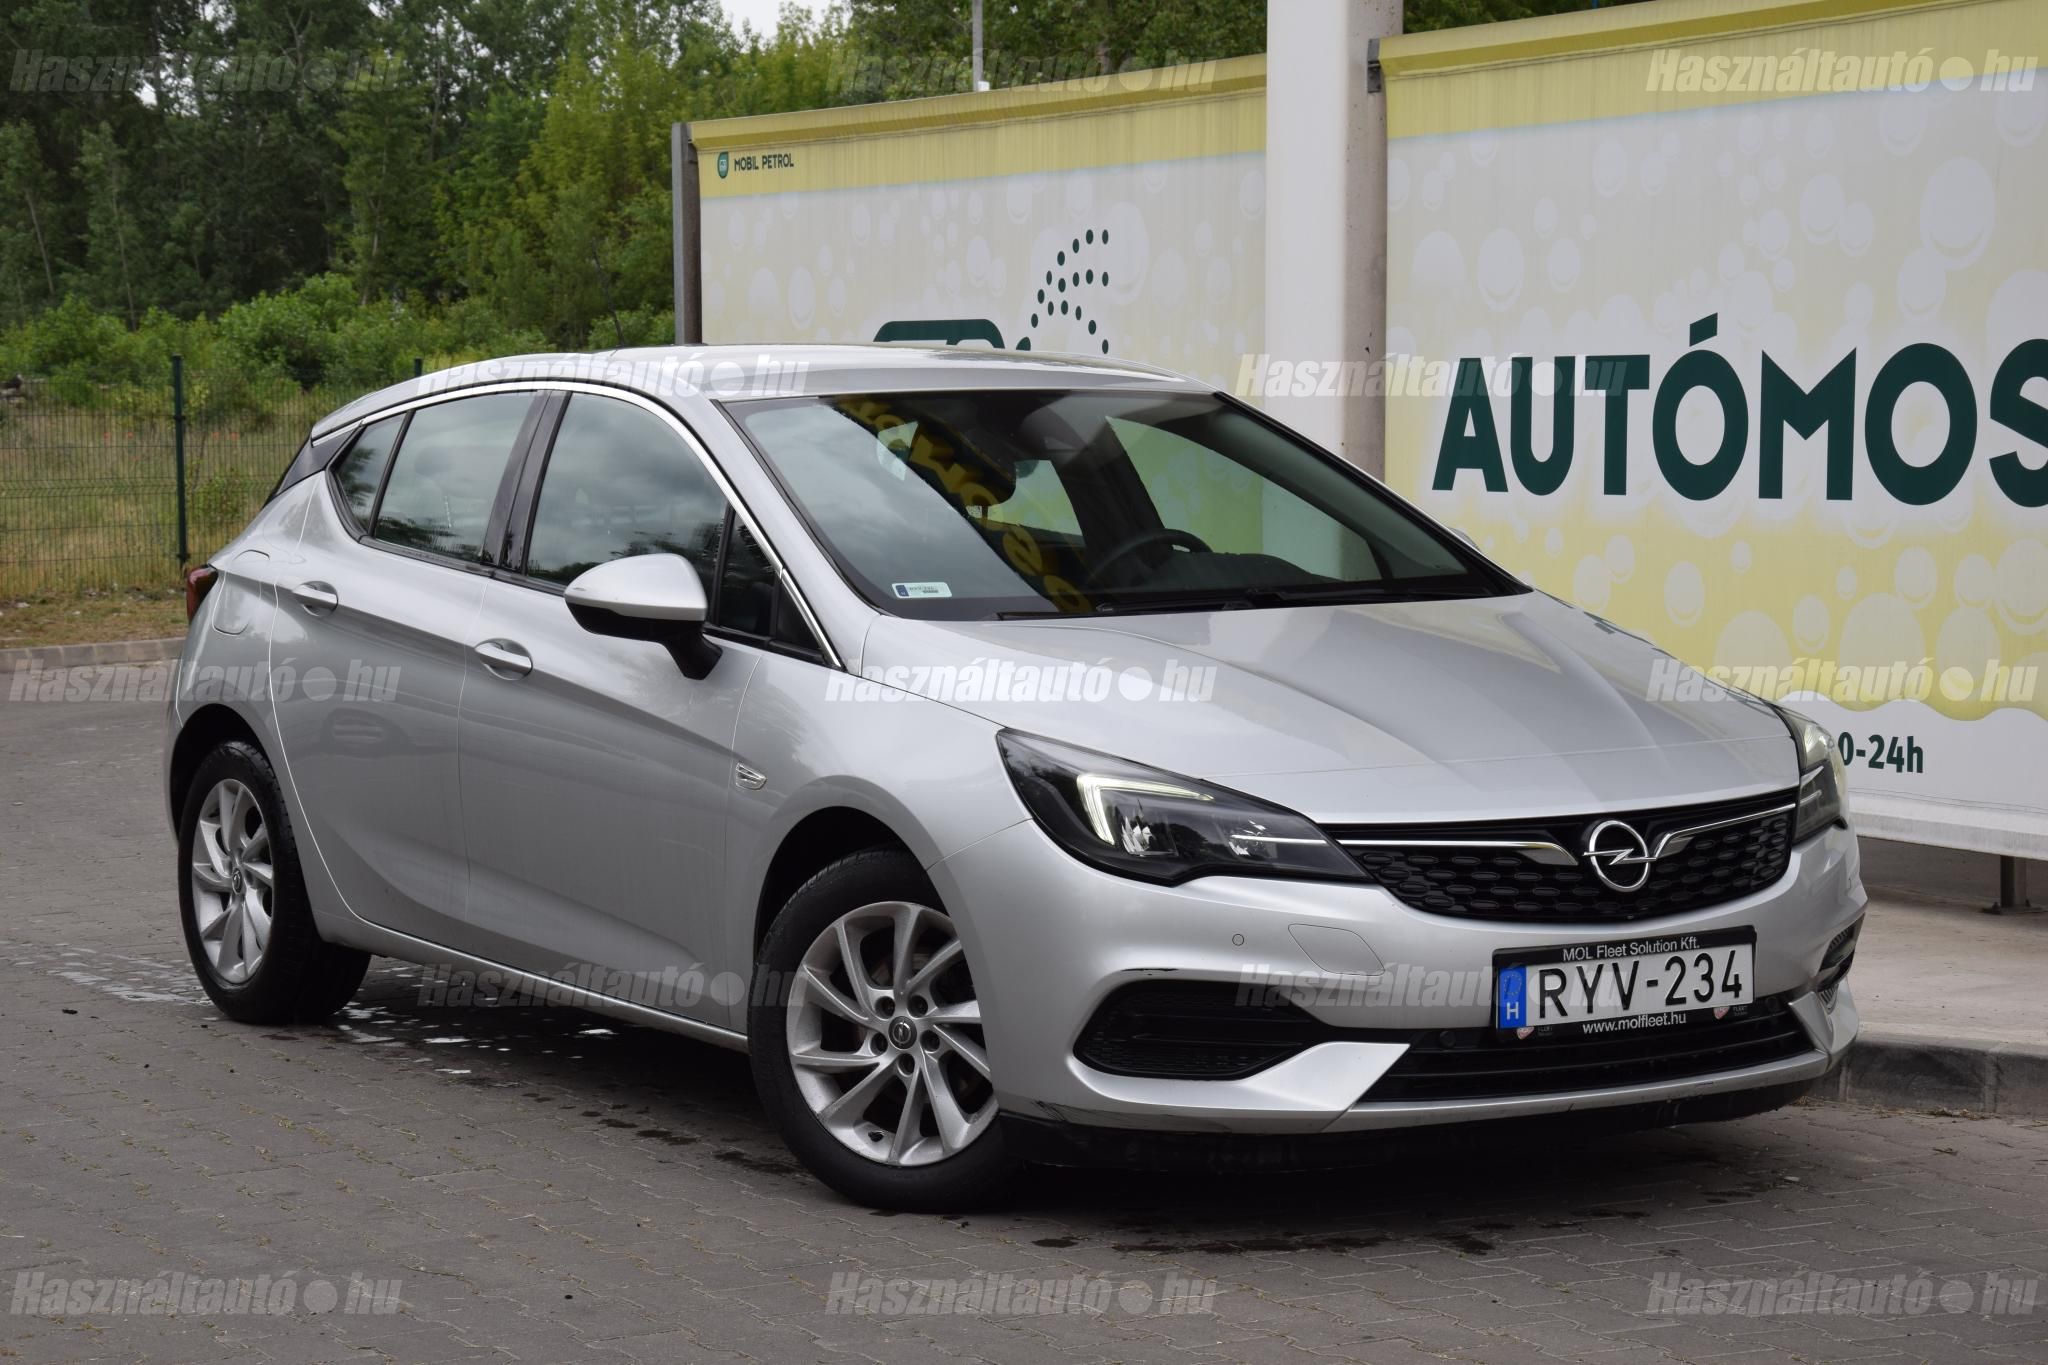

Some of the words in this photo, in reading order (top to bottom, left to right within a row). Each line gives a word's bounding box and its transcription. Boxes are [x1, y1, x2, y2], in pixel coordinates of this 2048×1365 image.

[734, 156, 759, 171] MOBIL
[762, 153, 794, 168] PETROL
[1838, 731, 1923, 773] 0-24h
[1563, 947, 1594, 961] MOL
[1596, 944, 1627, 957] Fleet
[1630, 939, 1677, 955] Solution
[1680, 936, 1700, 950] Kft.
[1539, 950, 1743, 1019] RYV-234
[1505, 1002, 1519, 1021] H
[1582, 1011, 1687, 1035] www.molfleet.hu
